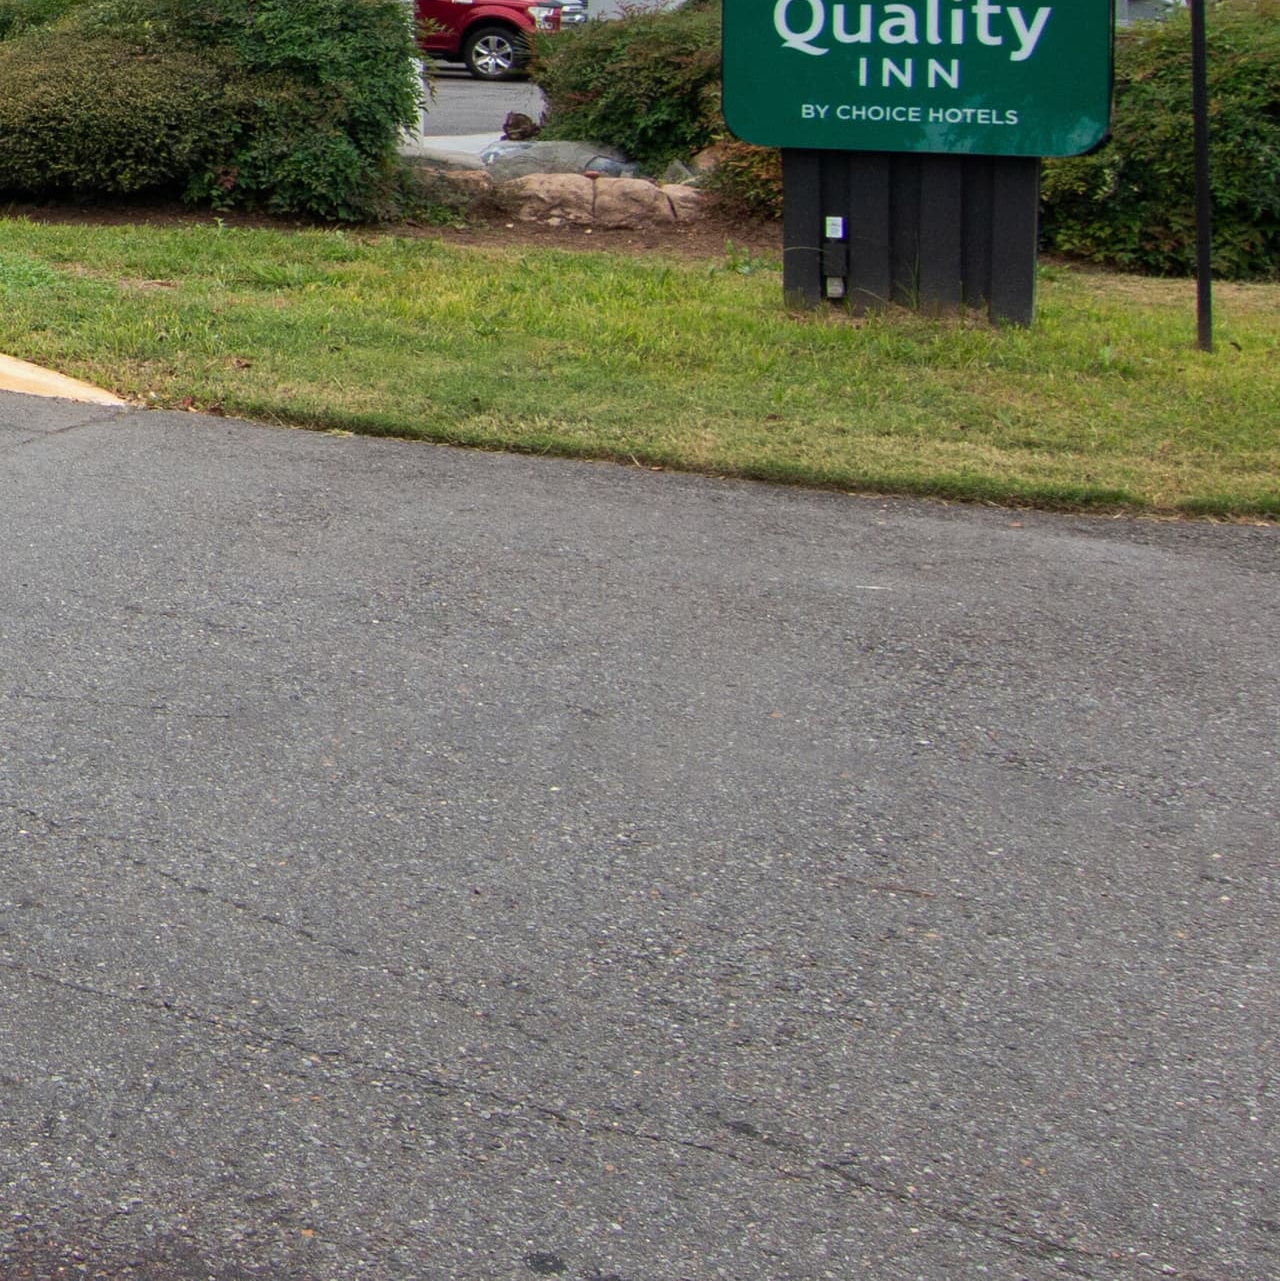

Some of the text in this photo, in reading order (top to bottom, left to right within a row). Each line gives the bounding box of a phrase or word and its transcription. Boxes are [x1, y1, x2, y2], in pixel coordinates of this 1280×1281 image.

[858, 57, 960, 89] INN
[801, 103, 1019, 125] BY CHOICE HOTELS
